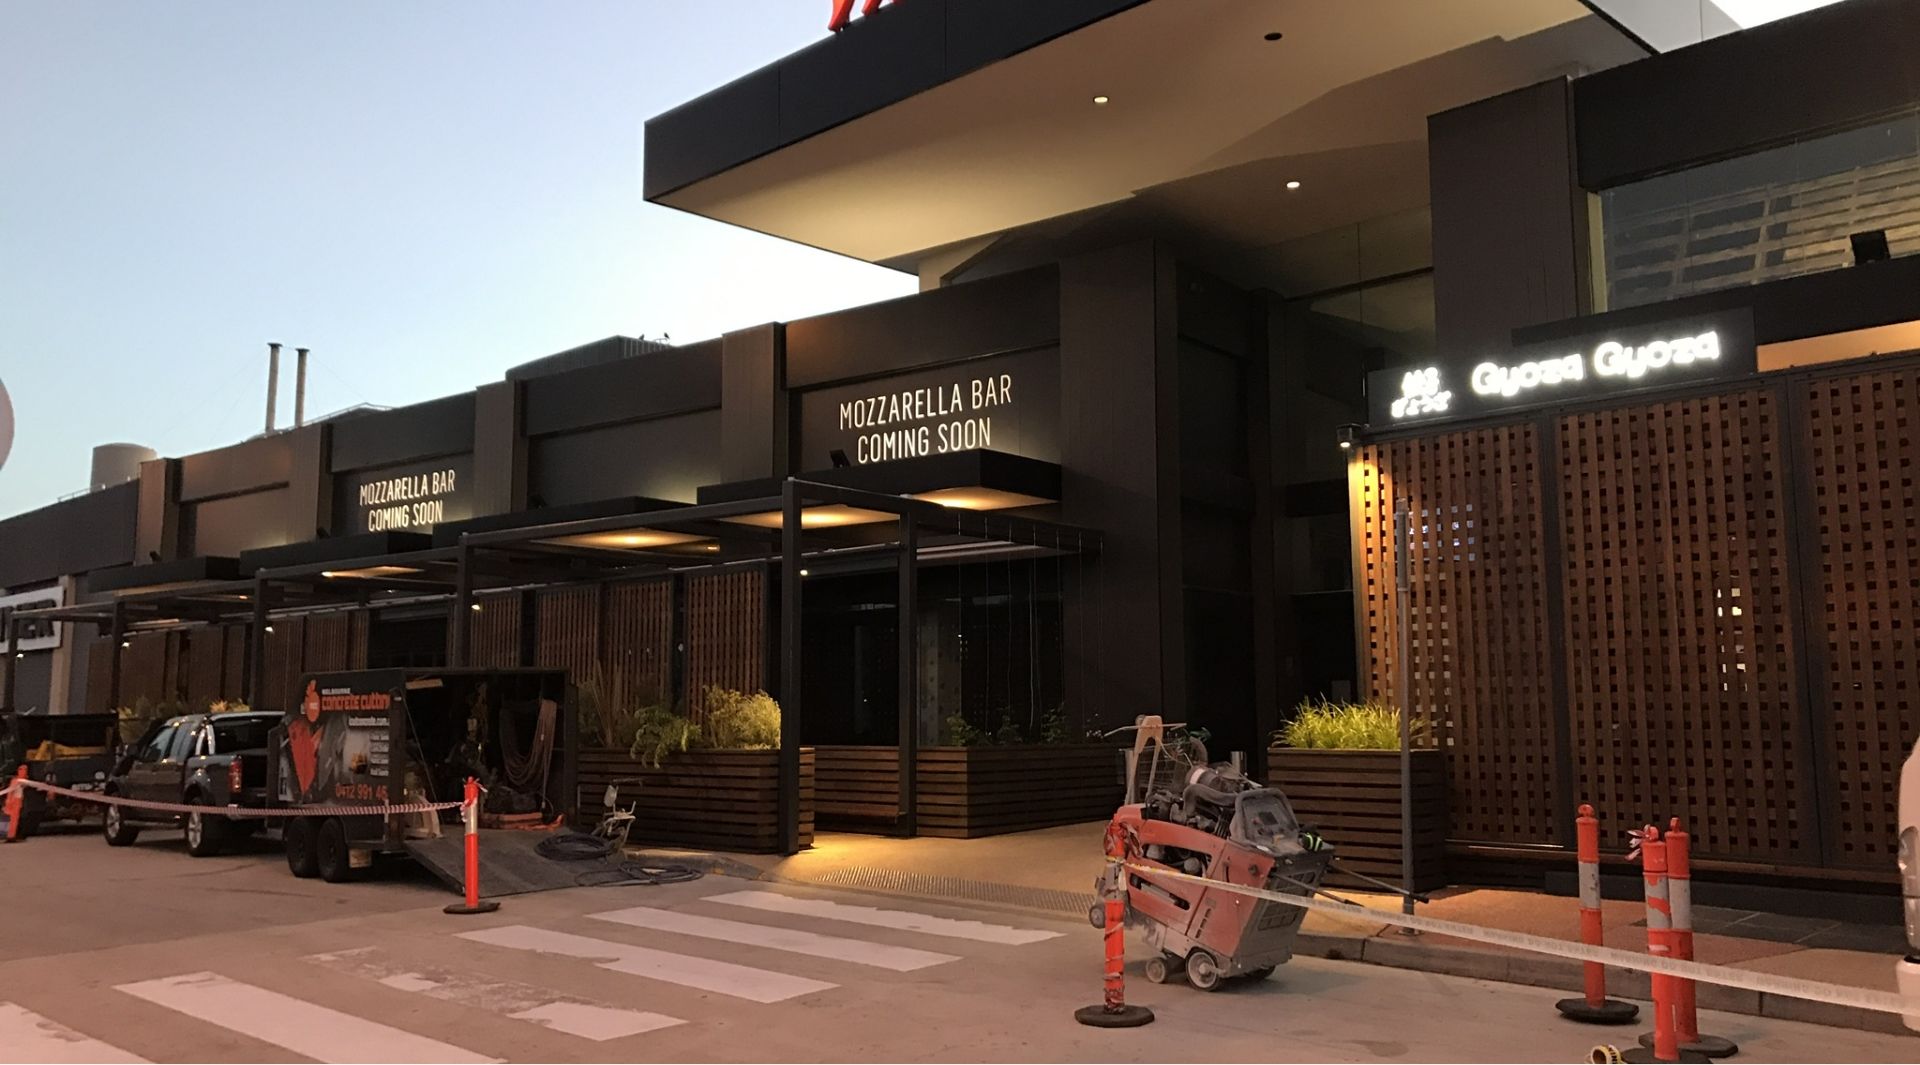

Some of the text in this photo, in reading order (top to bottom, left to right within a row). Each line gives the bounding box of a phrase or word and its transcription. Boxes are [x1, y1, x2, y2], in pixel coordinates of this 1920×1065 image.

[1471, 331, 1721, 397] Gyoza Gyoza
[839, 374, 1012, 431] MOZZARELLA BAR
[857, 417, 991, 464] COMING SOON
[360, 469, 456, 507] MOZZARELLA BAR
[368, 500, 443, 532] COMING SOON
